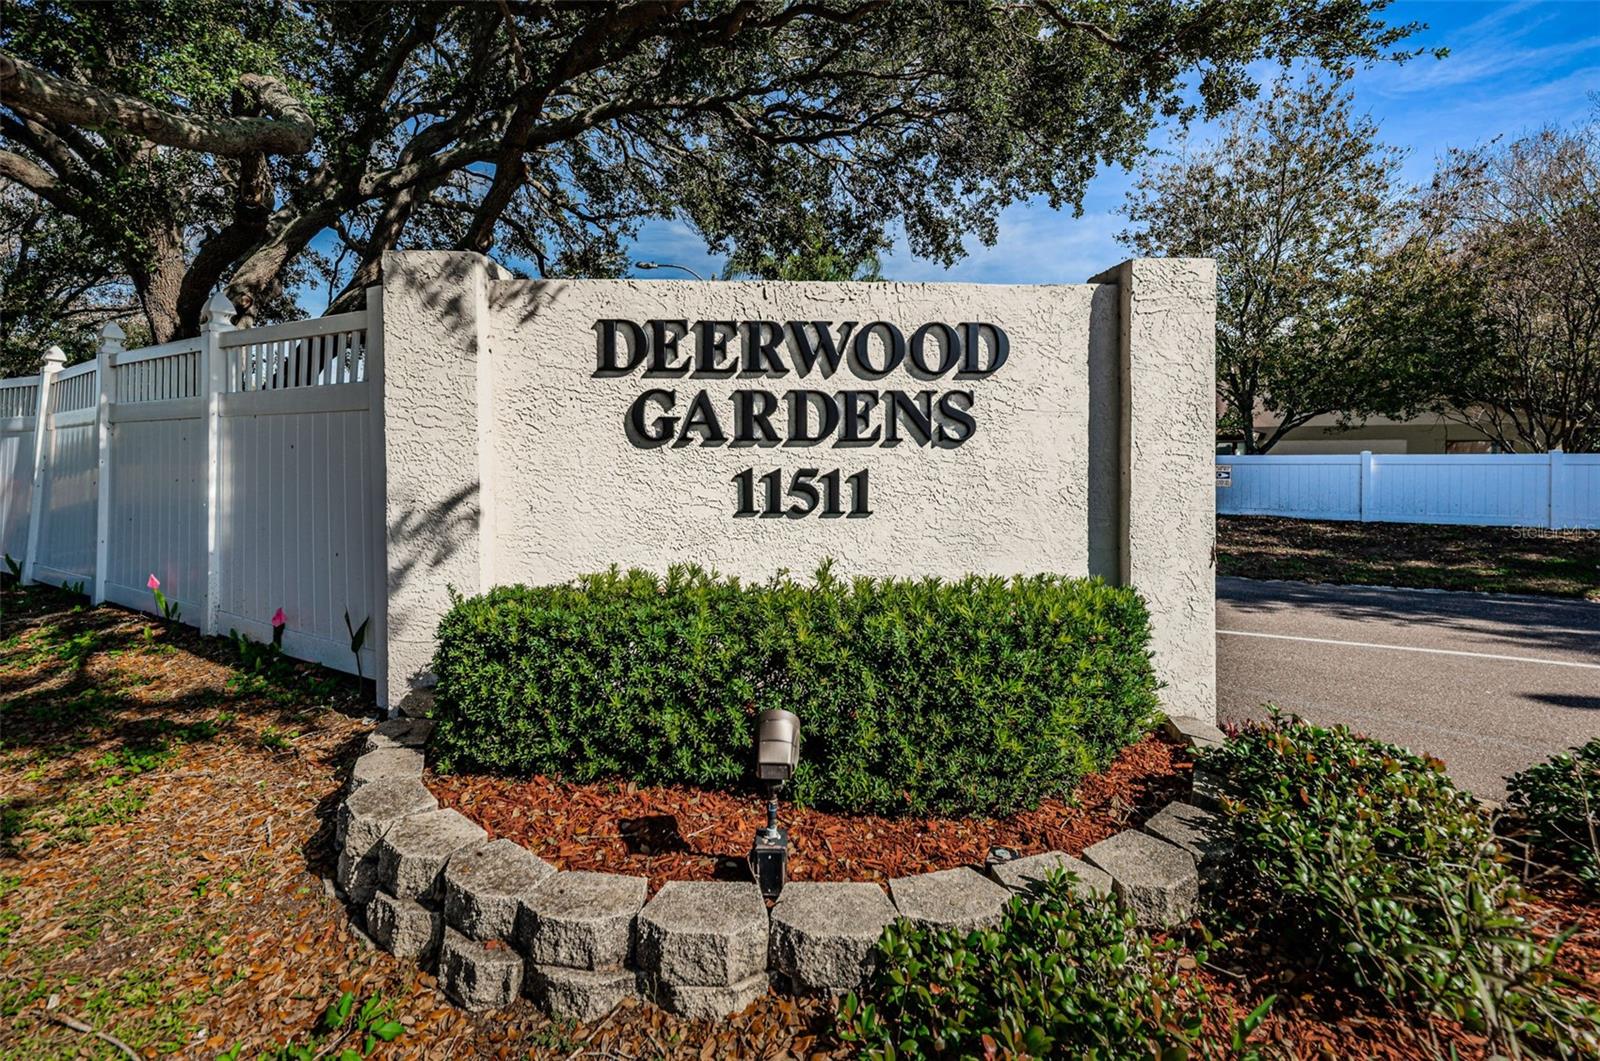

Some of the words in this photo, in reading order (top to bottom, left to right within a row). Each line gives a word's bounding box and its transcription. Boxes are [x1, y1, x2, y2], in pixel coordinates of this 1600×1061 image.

[591, 318, 1010, 381] DEERWOOD
[623, 388, 977, 449] GARDENS
[731, 467, 874, 519] 11511
